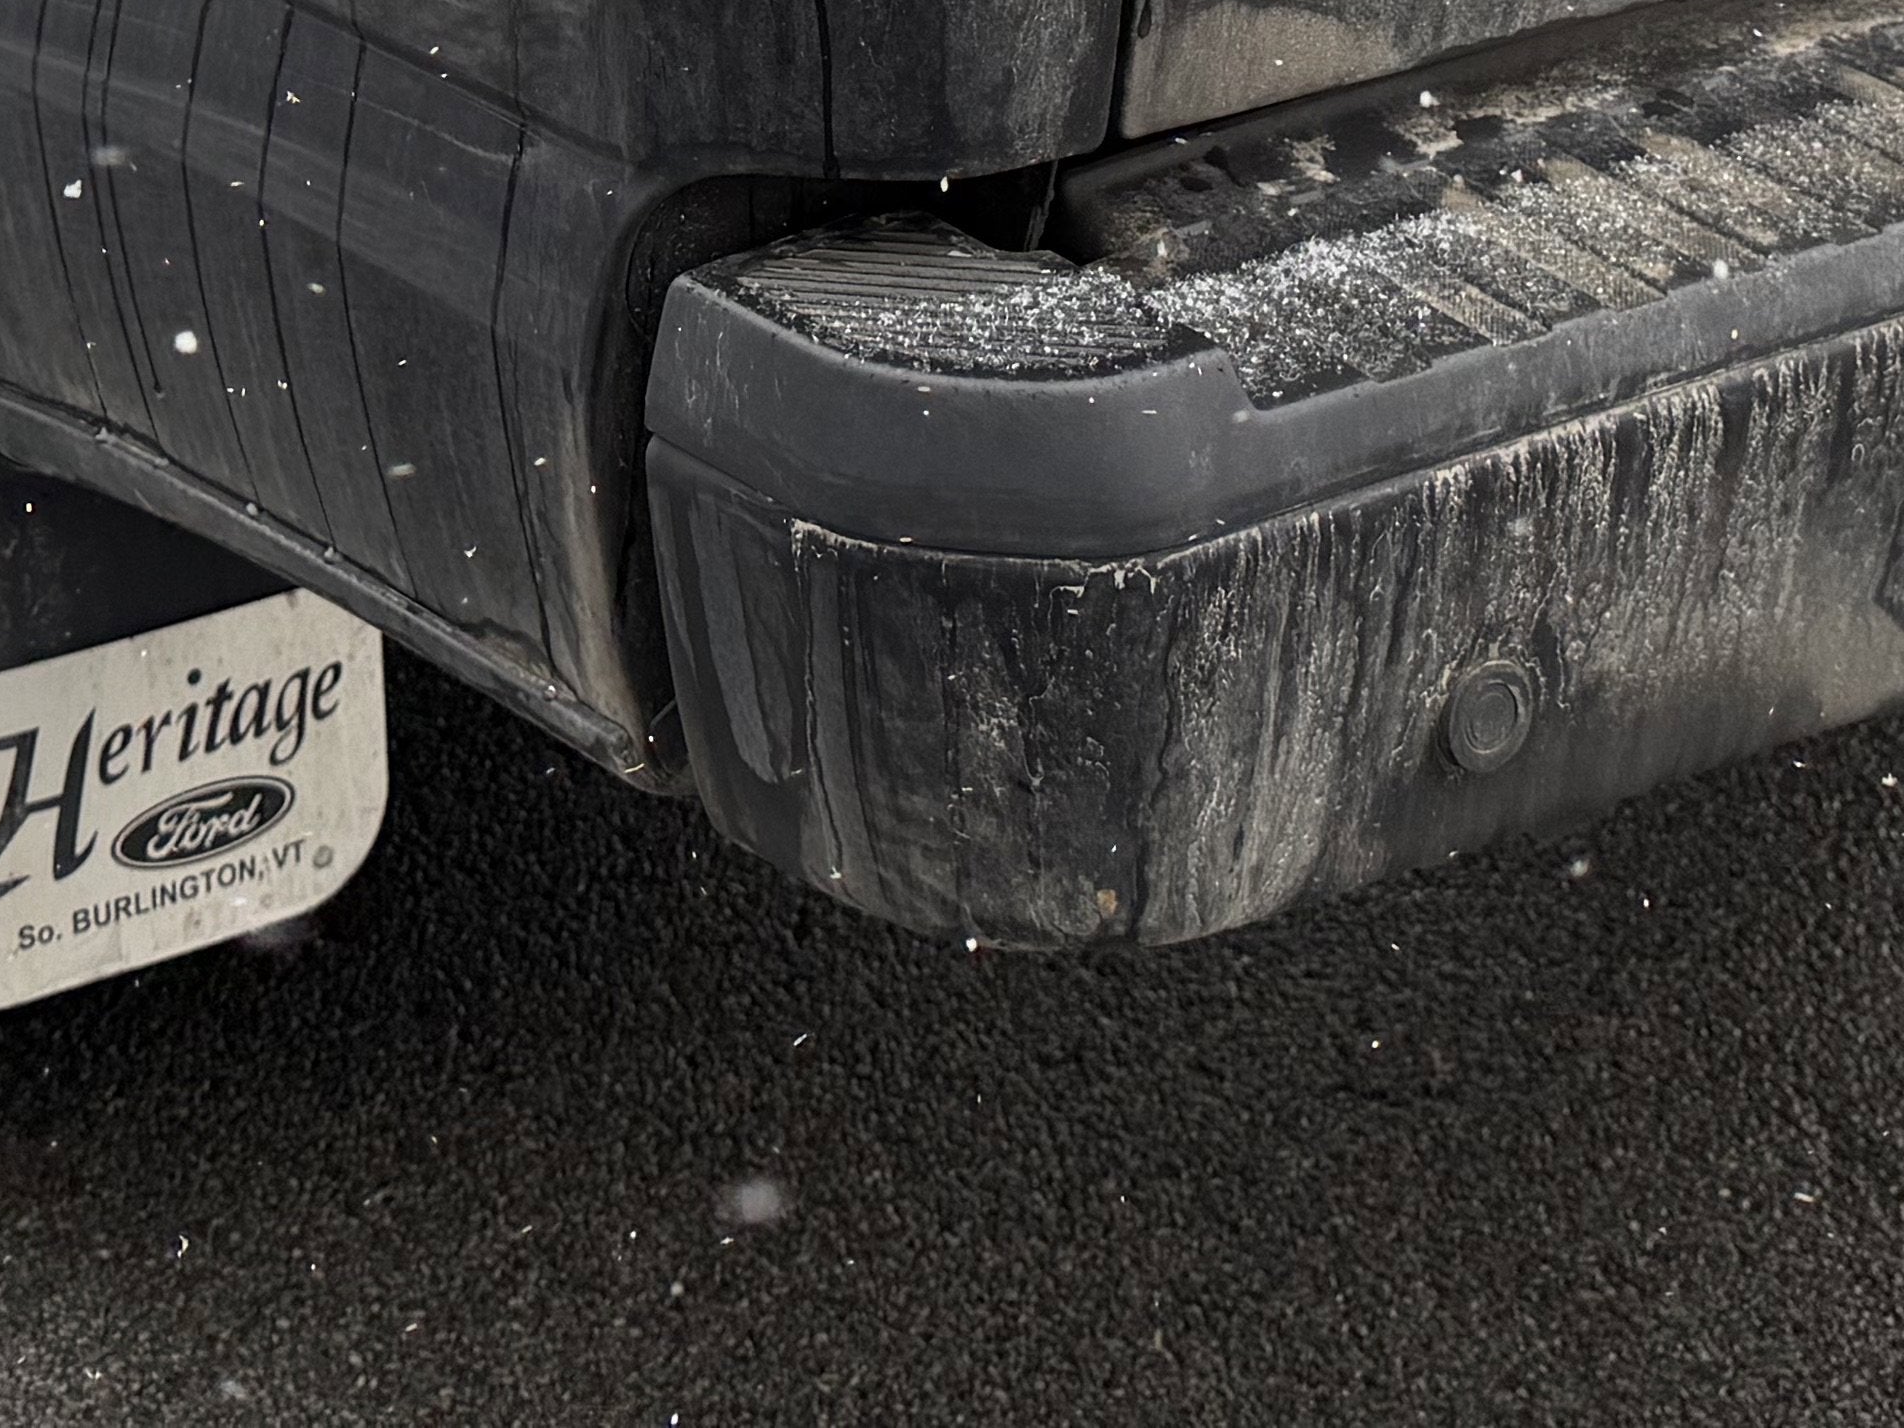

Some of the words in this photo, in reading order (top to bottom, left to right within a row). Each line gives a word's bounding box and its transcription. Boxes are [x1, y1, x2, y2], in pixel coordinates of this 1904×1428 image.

[147, 790, 264, 861] Ford
[17, 923, 63, 951] So.
[72, 854, 264, 935] BURLINGTON,
[272, 838, 307, 870] VT
